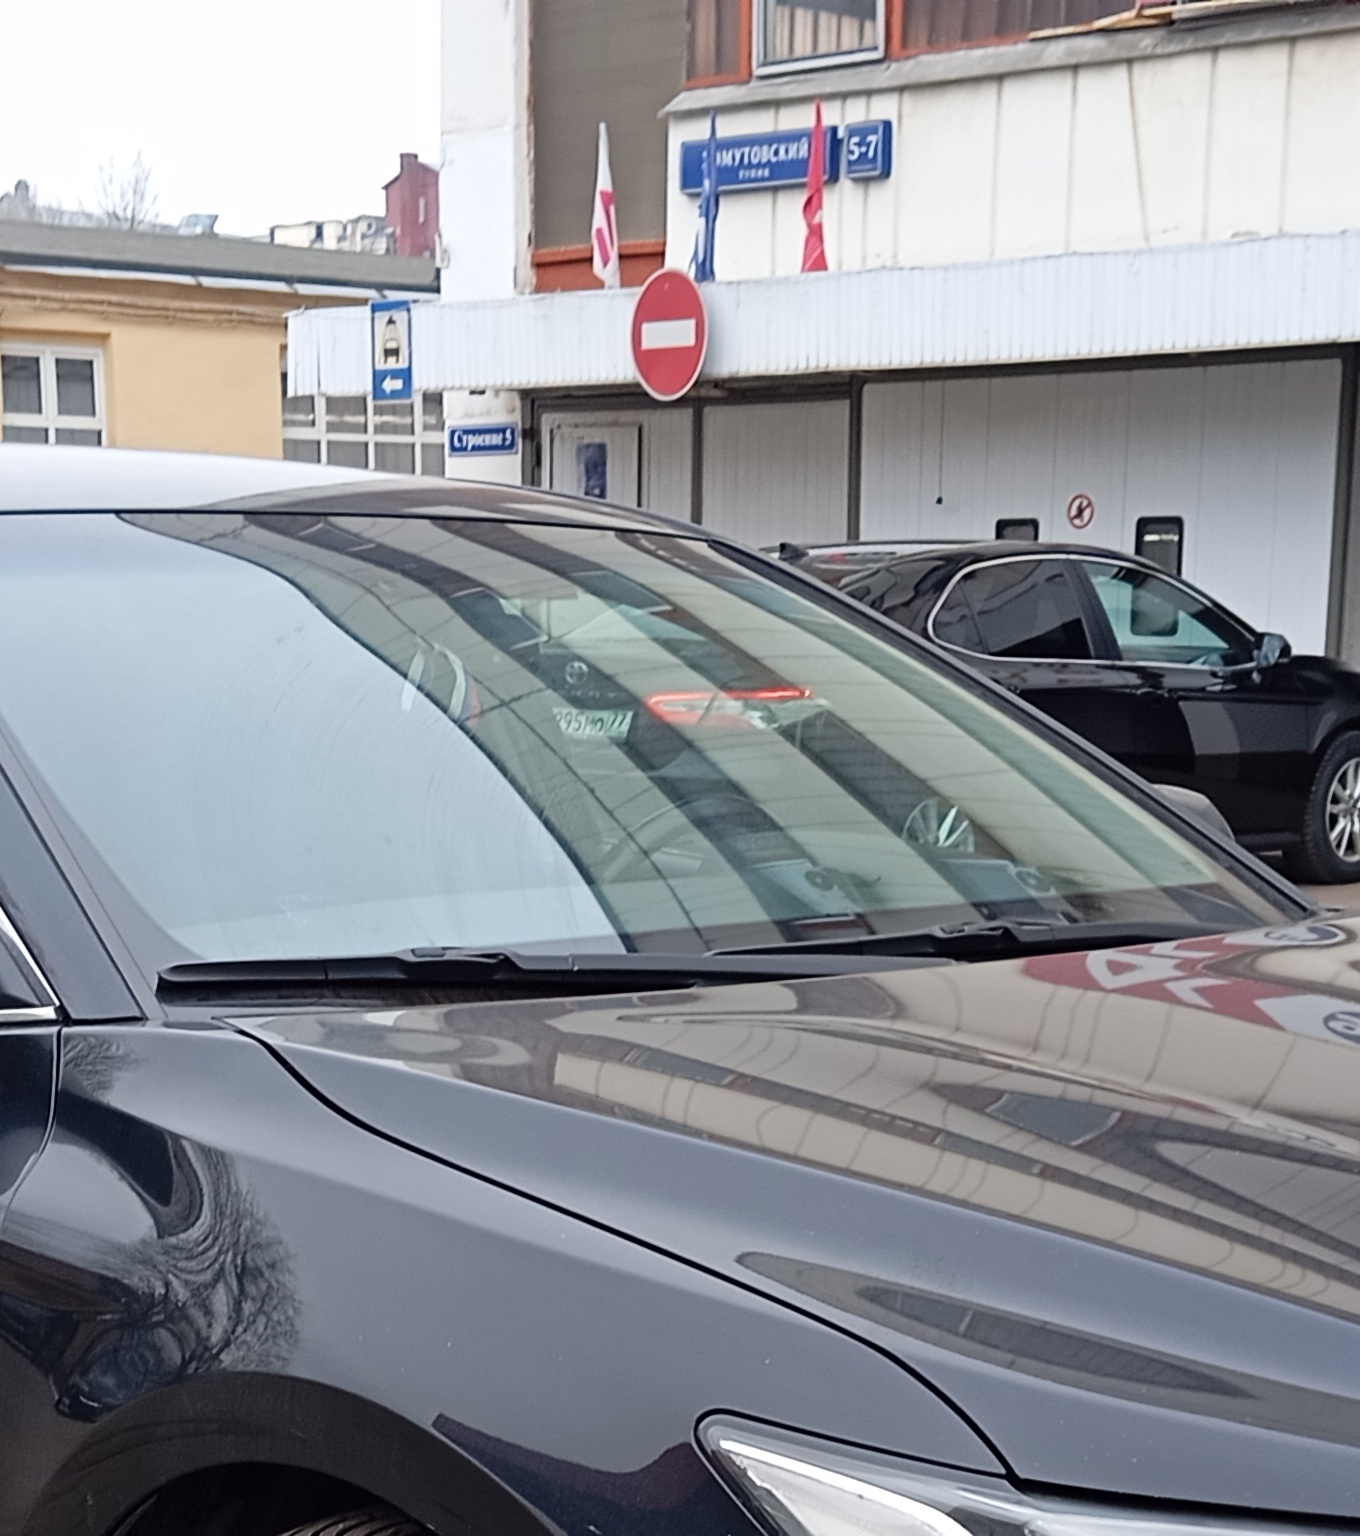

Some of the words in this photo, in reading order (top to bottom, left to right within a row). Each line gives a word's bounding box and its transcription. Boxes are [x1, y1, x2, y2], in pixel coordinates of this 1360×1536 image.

[701, 137, 809, 167] МУТОВСКИЙ
[848, 134, 879, 161] 5-7
[505, 428, 512, 446] 5
